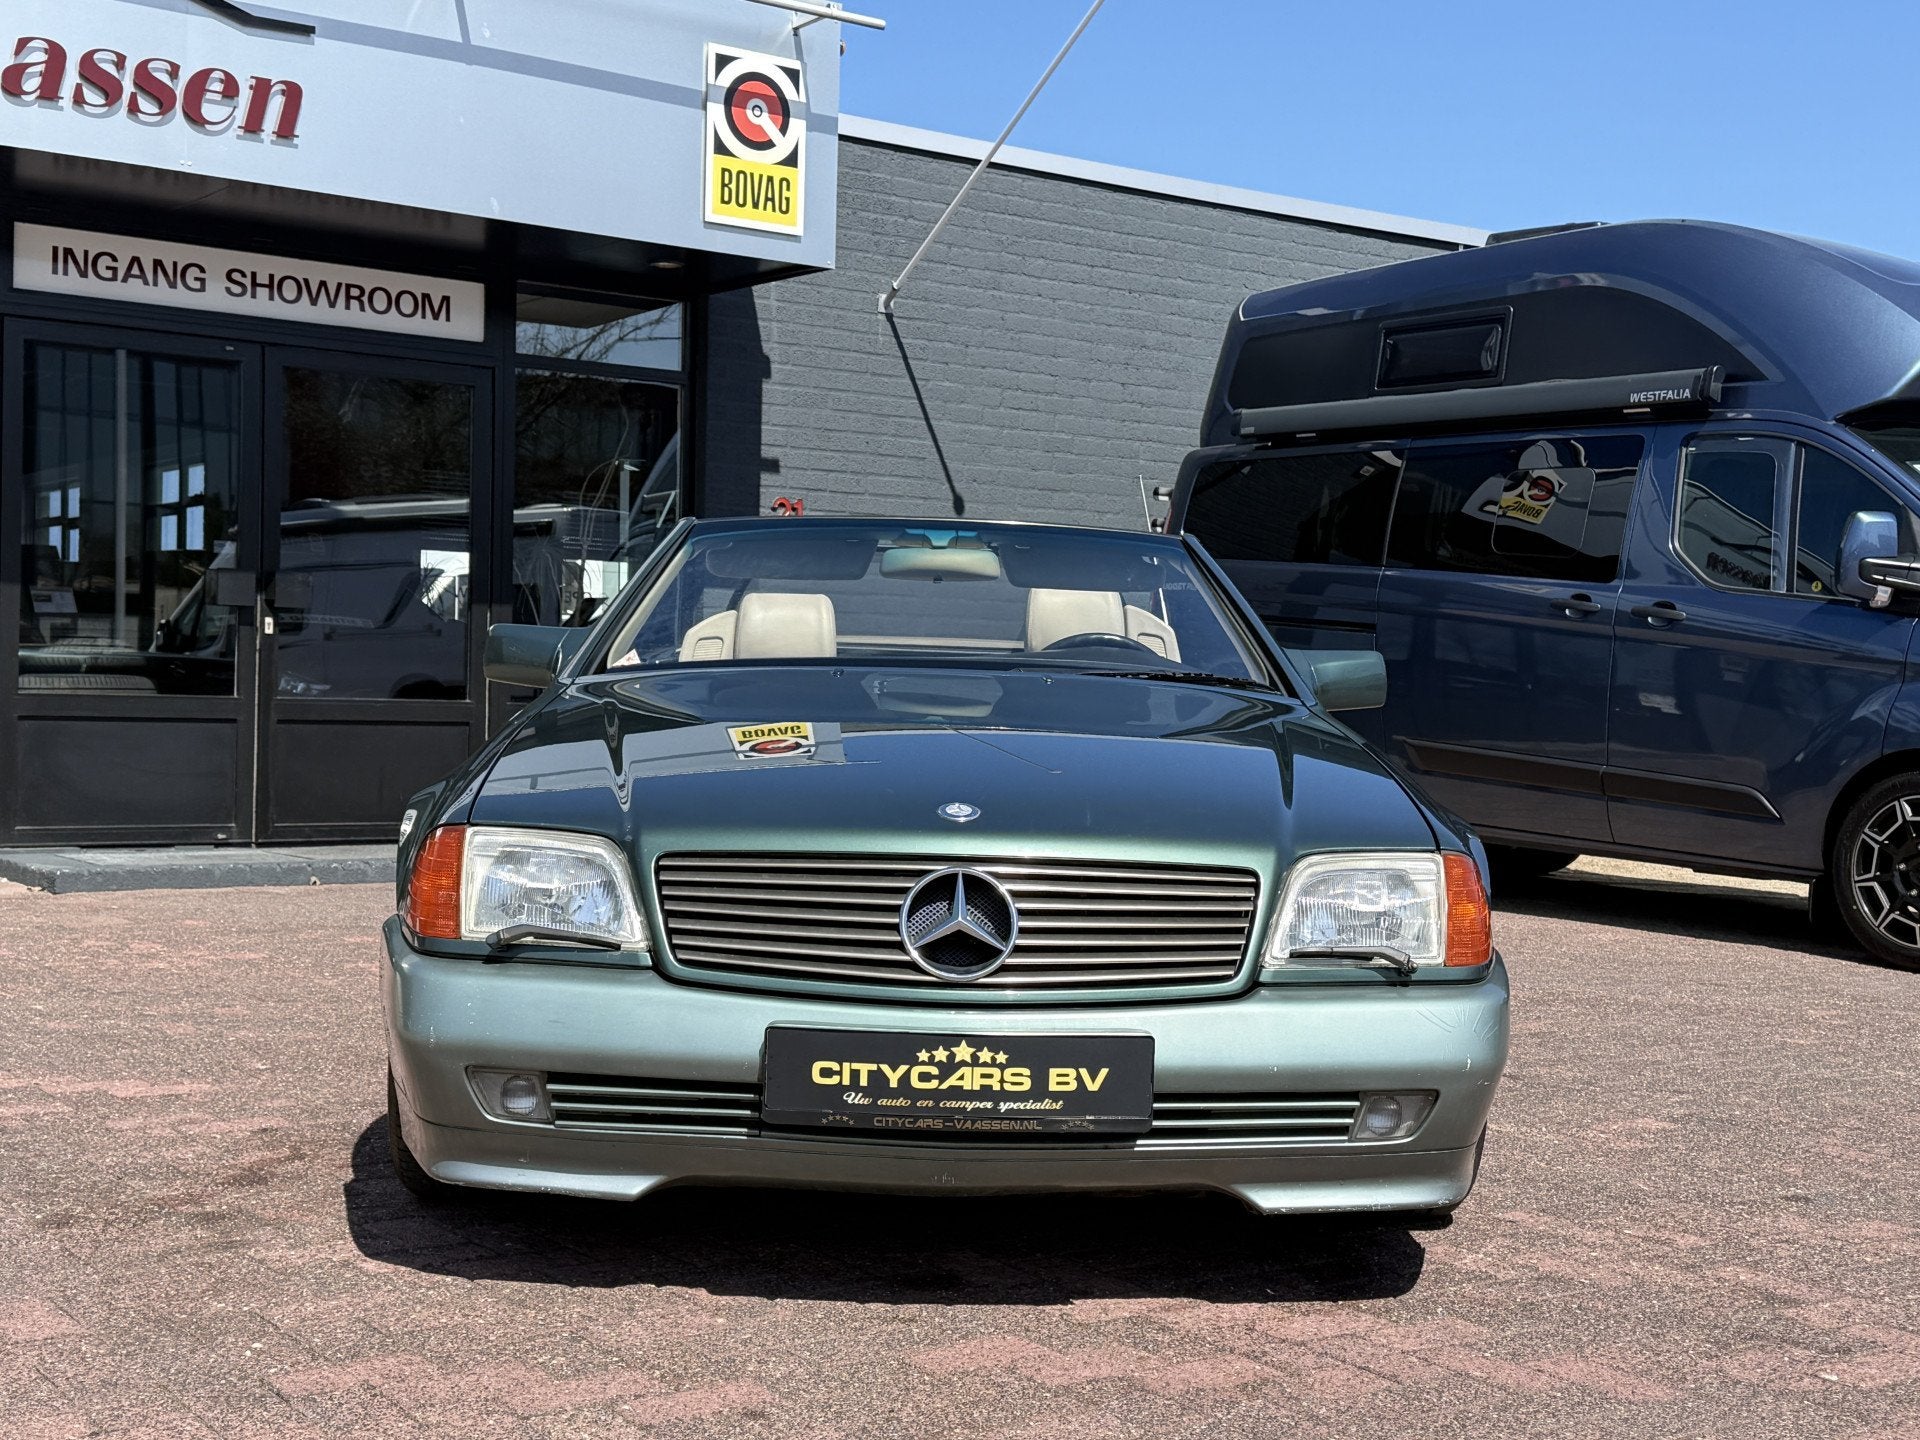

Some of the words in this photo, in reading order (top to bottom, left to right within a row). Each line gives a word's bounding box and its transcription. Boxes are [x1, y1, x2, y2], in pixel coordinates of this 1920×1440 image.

[1, 36, 303, 138] assen
[720, 167, 791, 215] BOVAG
[51, 245, 207, 293] INGANG
[225, 268, 451, 322] SHOWROOM
[1630, 388, 1691, 403] WESTFALIA
[770, 496, 804, 517] 21
[811, 1061, 1032, 1092] CITYCARS
[1048, 1067, 1110, 1092] BV
[843, 1092, 872, 1105] Uw
[877, 1097, 911, 1107] auto
[939, 1100, 993, 1111] camper
[997, 1098, 1064, 1112] specialist
[873, 1116, 1042, 1130] CITYCARS-VAASSEN.NL
